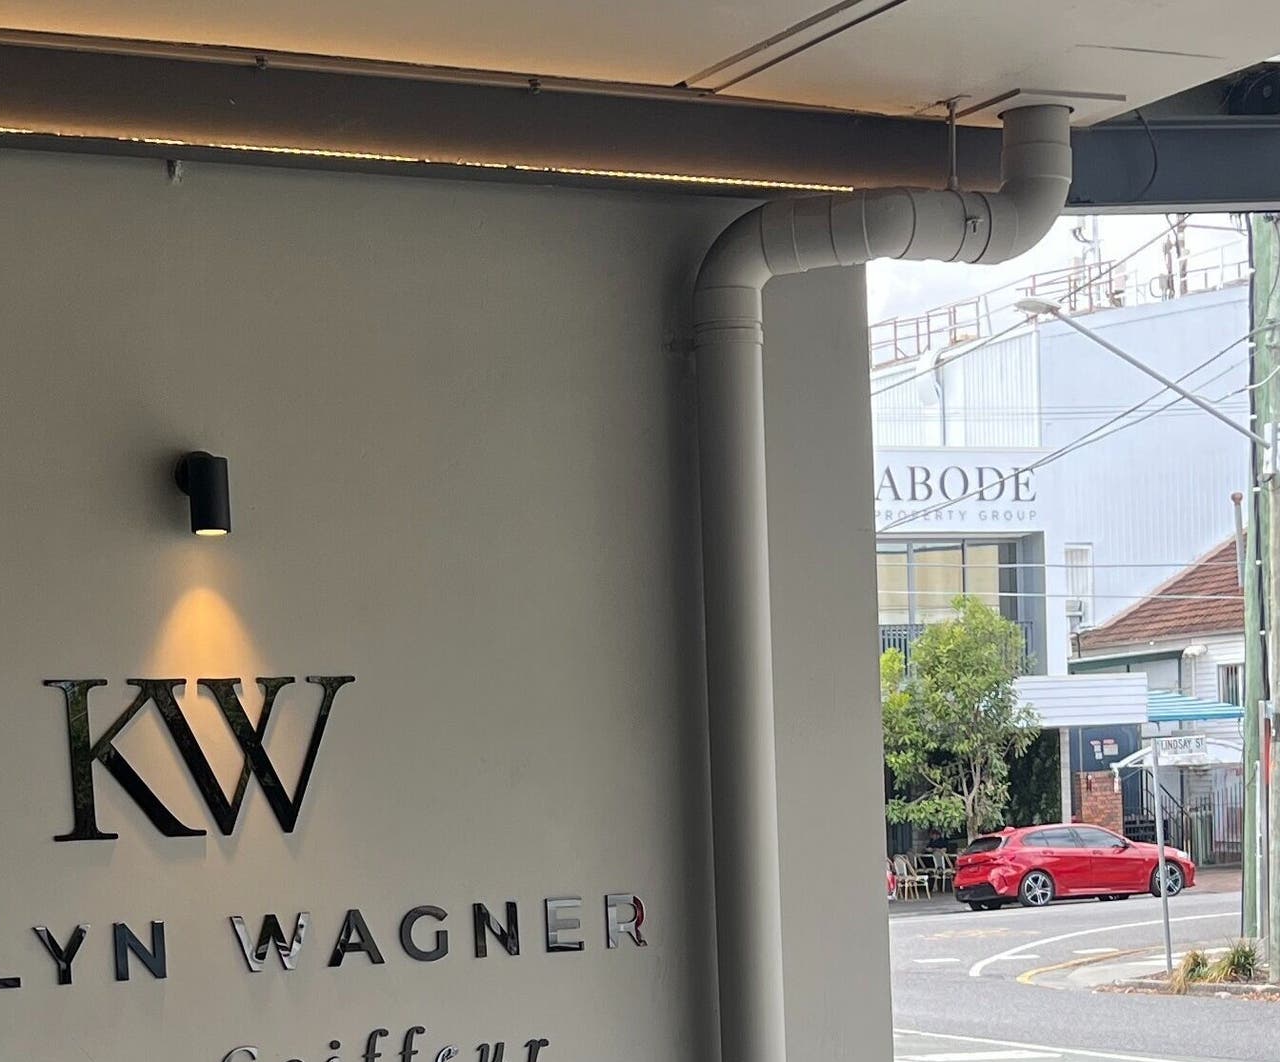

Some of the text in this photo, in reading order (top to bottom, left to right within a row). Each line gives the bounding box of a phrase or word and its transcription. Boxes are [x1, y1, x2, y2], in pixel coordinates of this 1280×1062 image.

[875, 465, 1037, 502] ABODE
[978, 509, 1037, 521] GROUP
[43, 675, 356, 842] KW
[1161, 738, 1192, 751] LINDSAY
[230, 893, 649, 973] WAGNER
